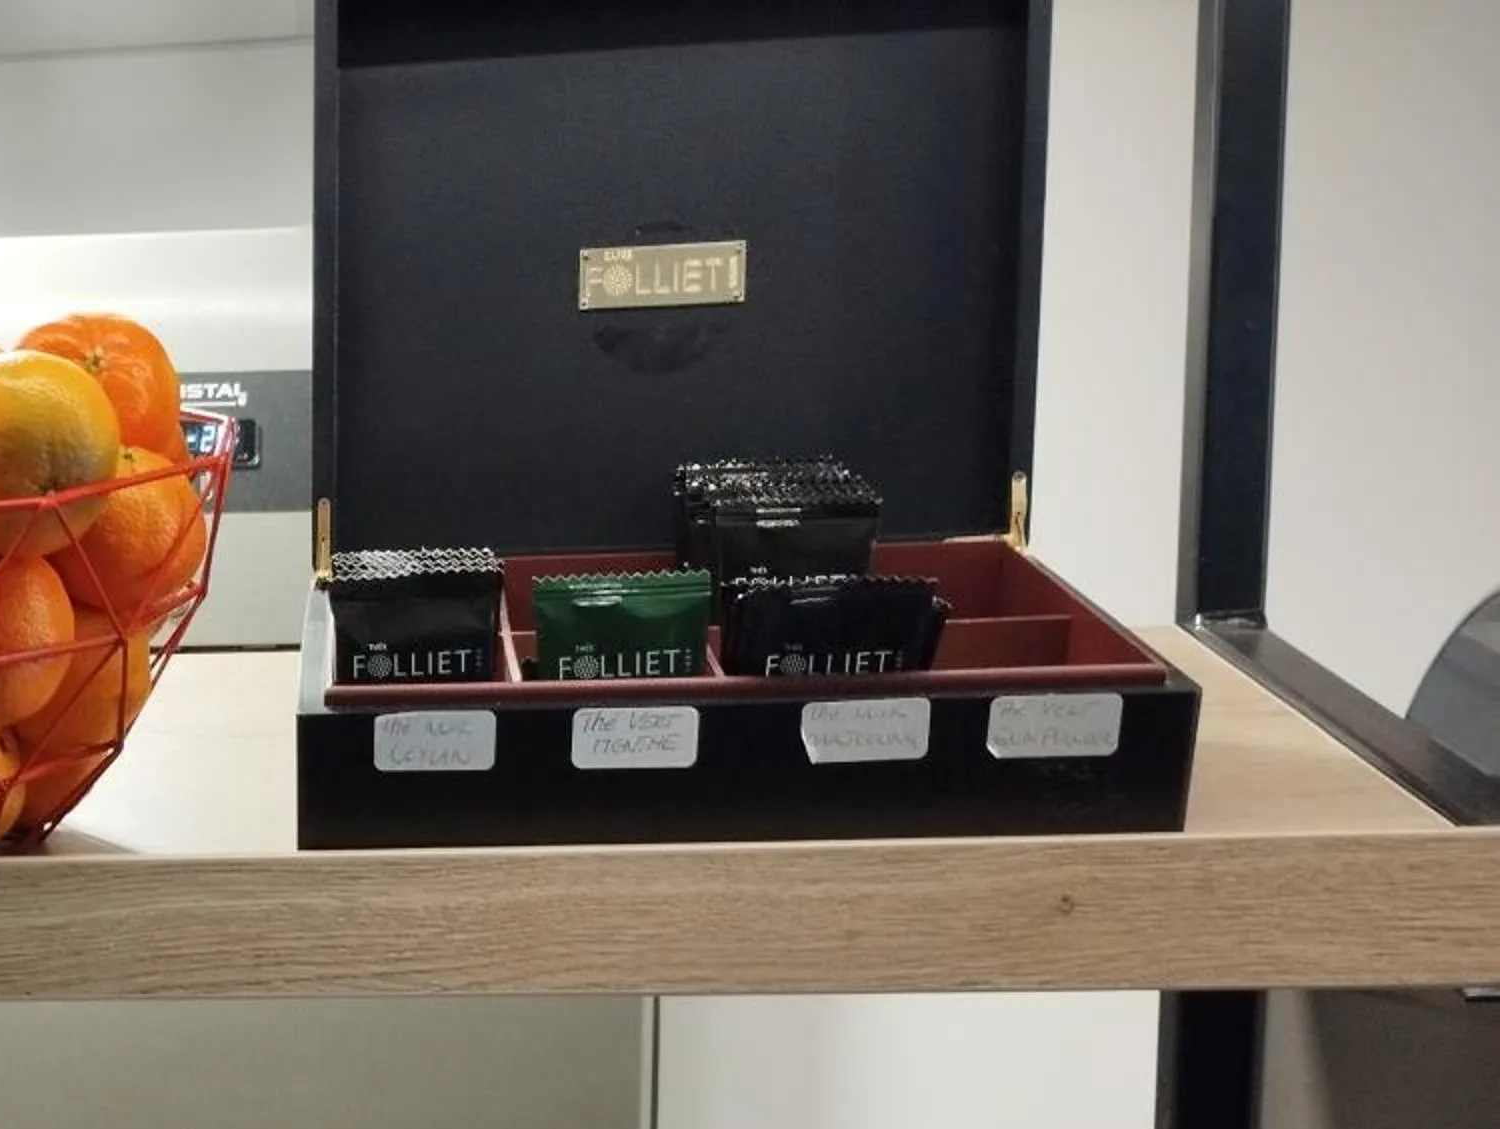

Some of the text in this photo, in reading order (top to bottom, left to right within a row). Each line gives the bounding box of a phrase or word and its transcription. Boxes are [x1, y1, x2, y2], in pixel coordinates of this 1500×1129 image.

[587, 257, 724, 298] FOLLIET
[353, 649, 473, 680] FOLLIET
[559, 649, 681, 680] FOLLIET
